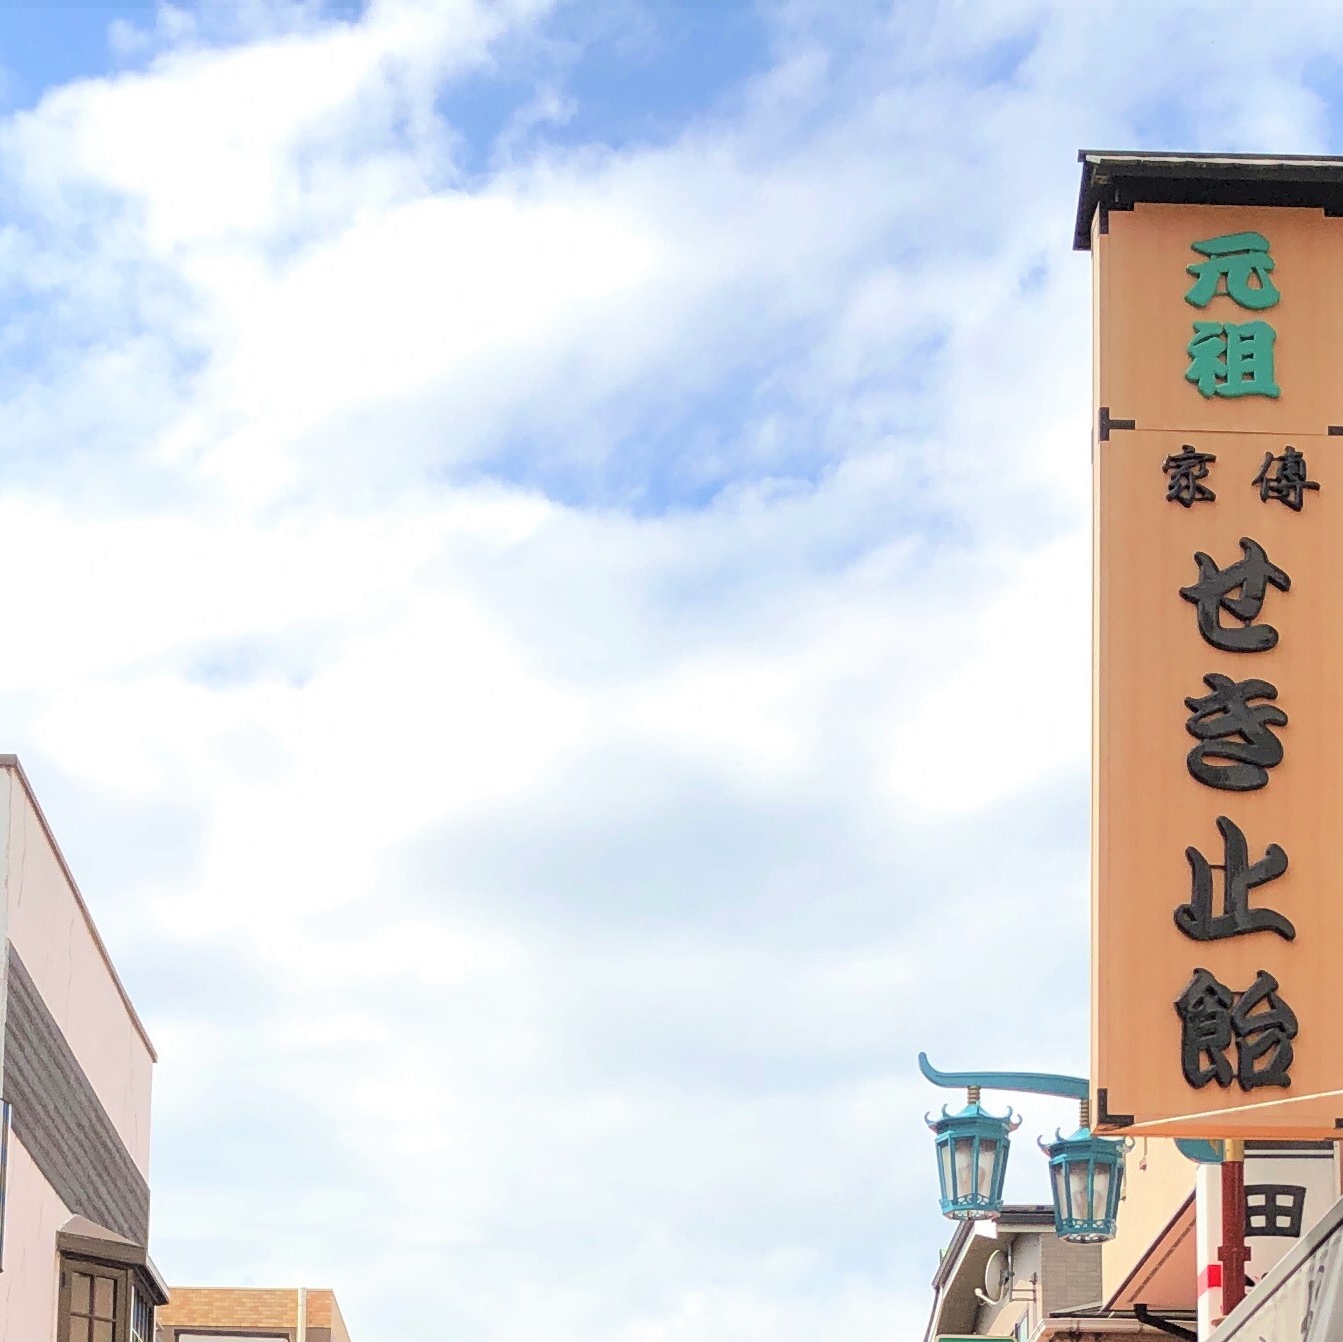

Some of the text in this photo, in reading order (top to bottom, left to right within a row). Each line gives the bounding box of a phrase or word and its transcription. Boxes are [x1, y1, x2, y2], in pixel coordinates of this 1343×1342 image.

[1185, 230, 1281, 400] 元祖
[1173, 537, 1299, 1092] せき止飴
